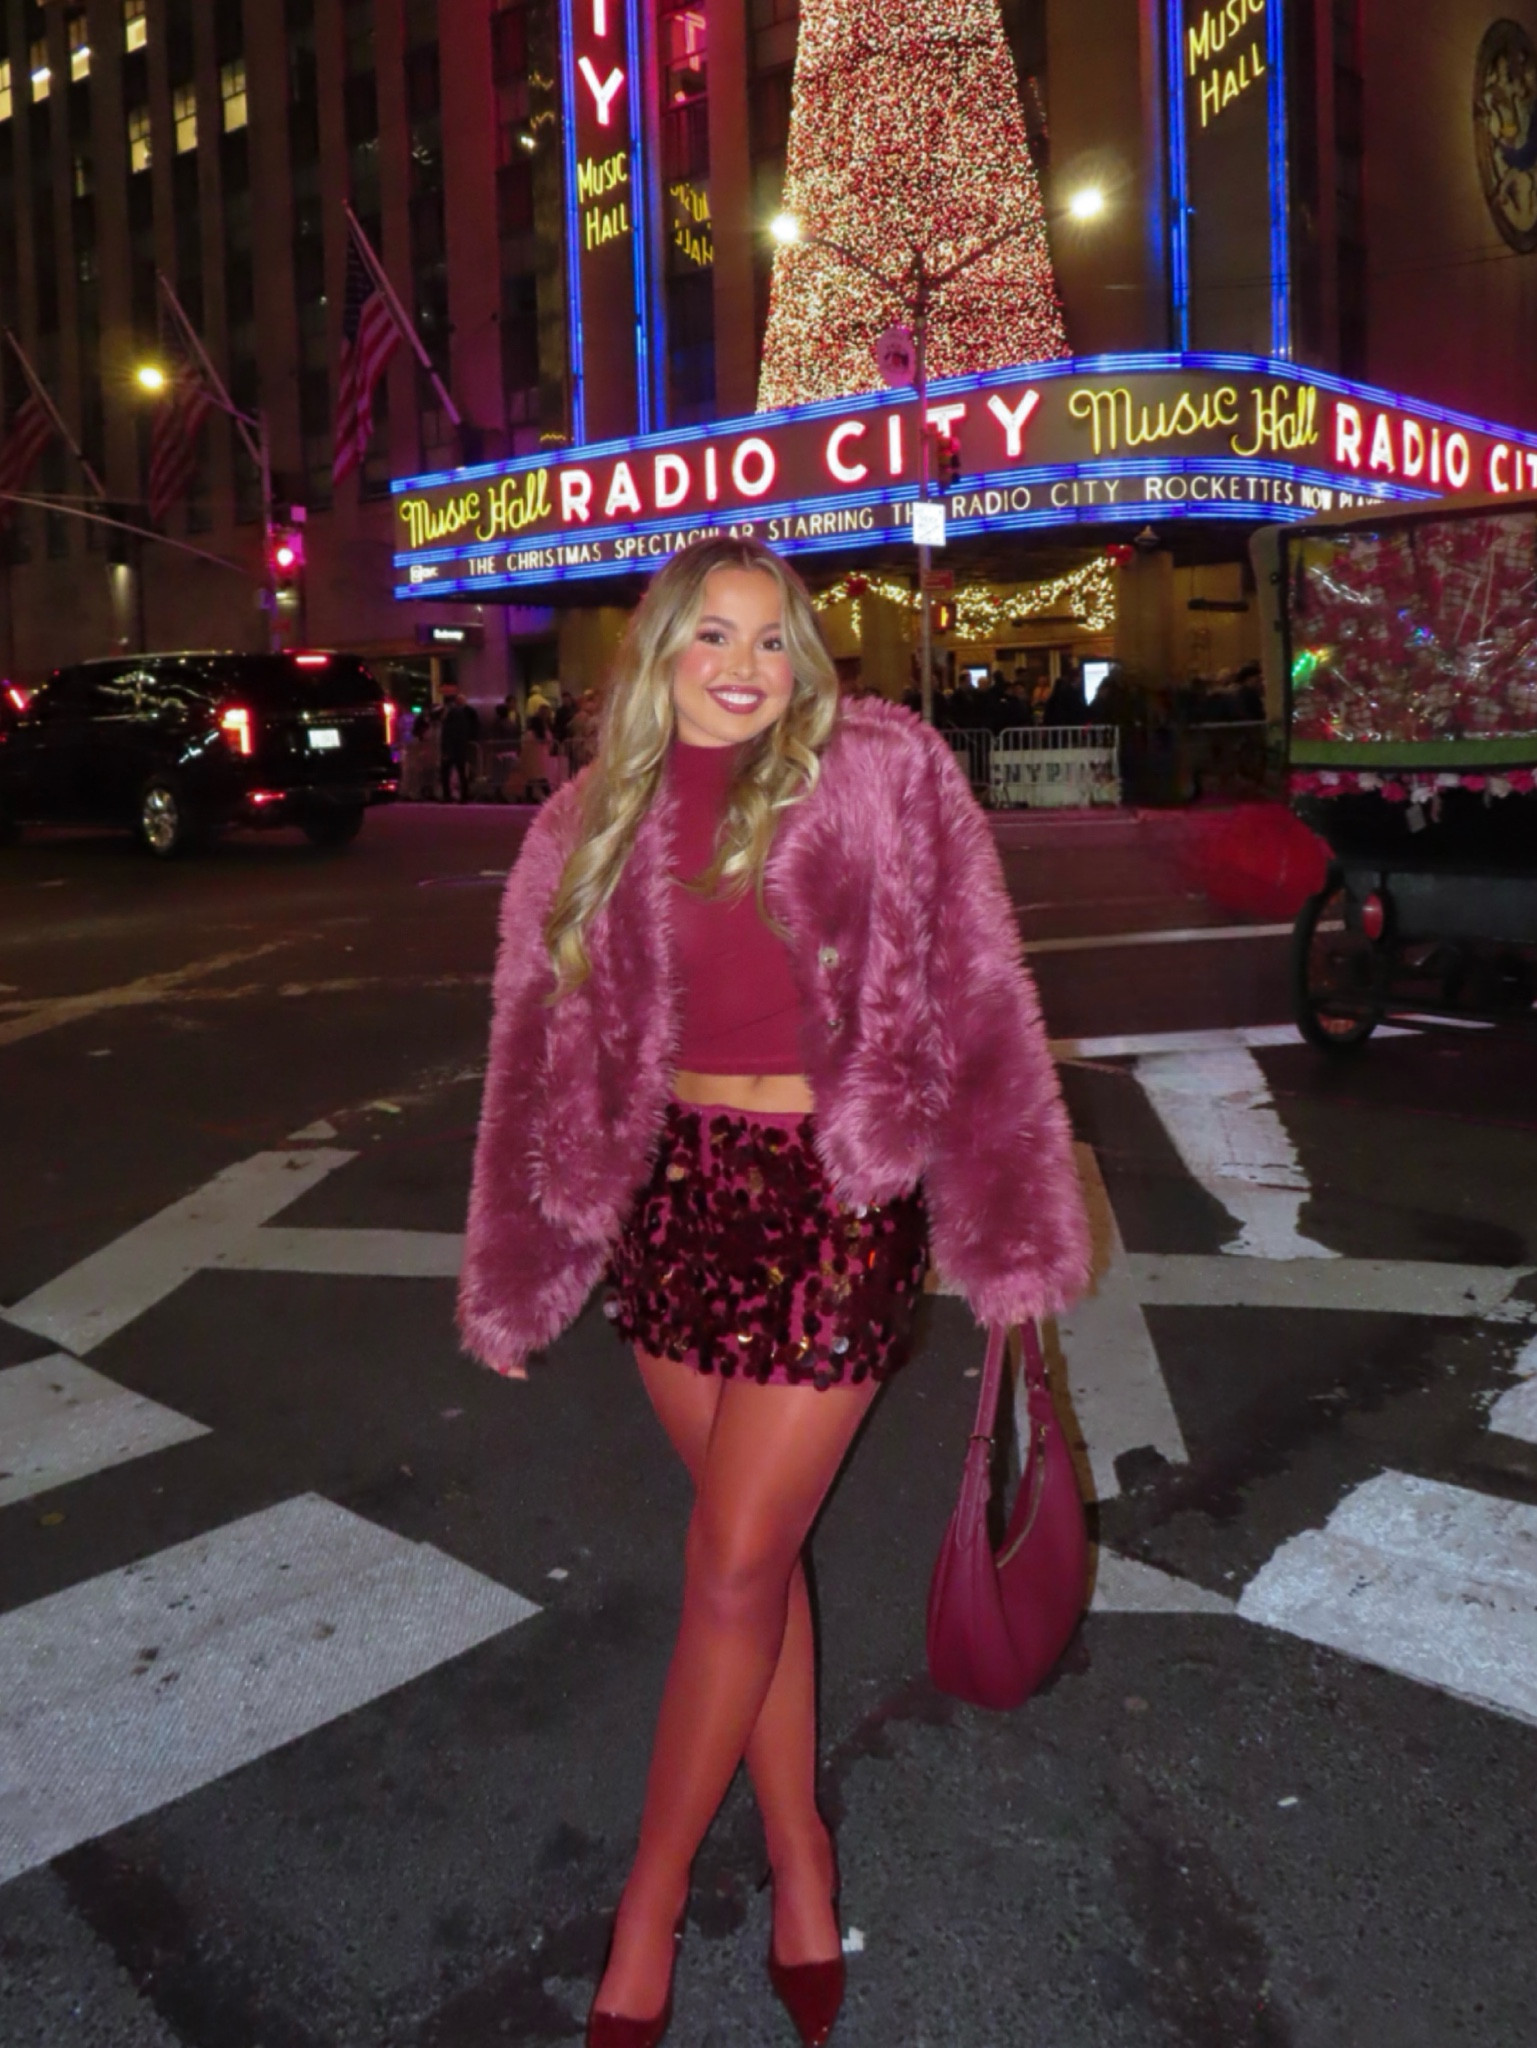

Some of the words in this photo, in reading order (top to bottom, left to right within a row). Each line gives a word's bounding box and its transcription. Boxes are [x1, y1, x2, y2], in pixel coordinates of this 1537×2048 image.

[1201, 43, 1265, 127] HALL
[577, 152, 628, 204] MUSIC
[586, 203, 629, 251] HALL
[400, 492, 480, 548] Music
[476, 468, 552, 541] Hall
[560, 437, 775, 521] RADIO
[1069, 386, 1238, 455] Music
[1231, 385, 1318, 455] Hall
[1336, 402, 1470, 488] RADIO
[468, 555, 496, 576] THE
[507, 543, 602, 572] CHRISTMAS
[768, 507, 874, 541] STARRING
[892, 503, 913, 526] TH
[952, 487, 1031, 518] RADIO
[1051, 479, 1119, 507] CITY
[1145, 476, 1294, 505] ROCKETTES
[1301, 485, 1333, 510] NOW
